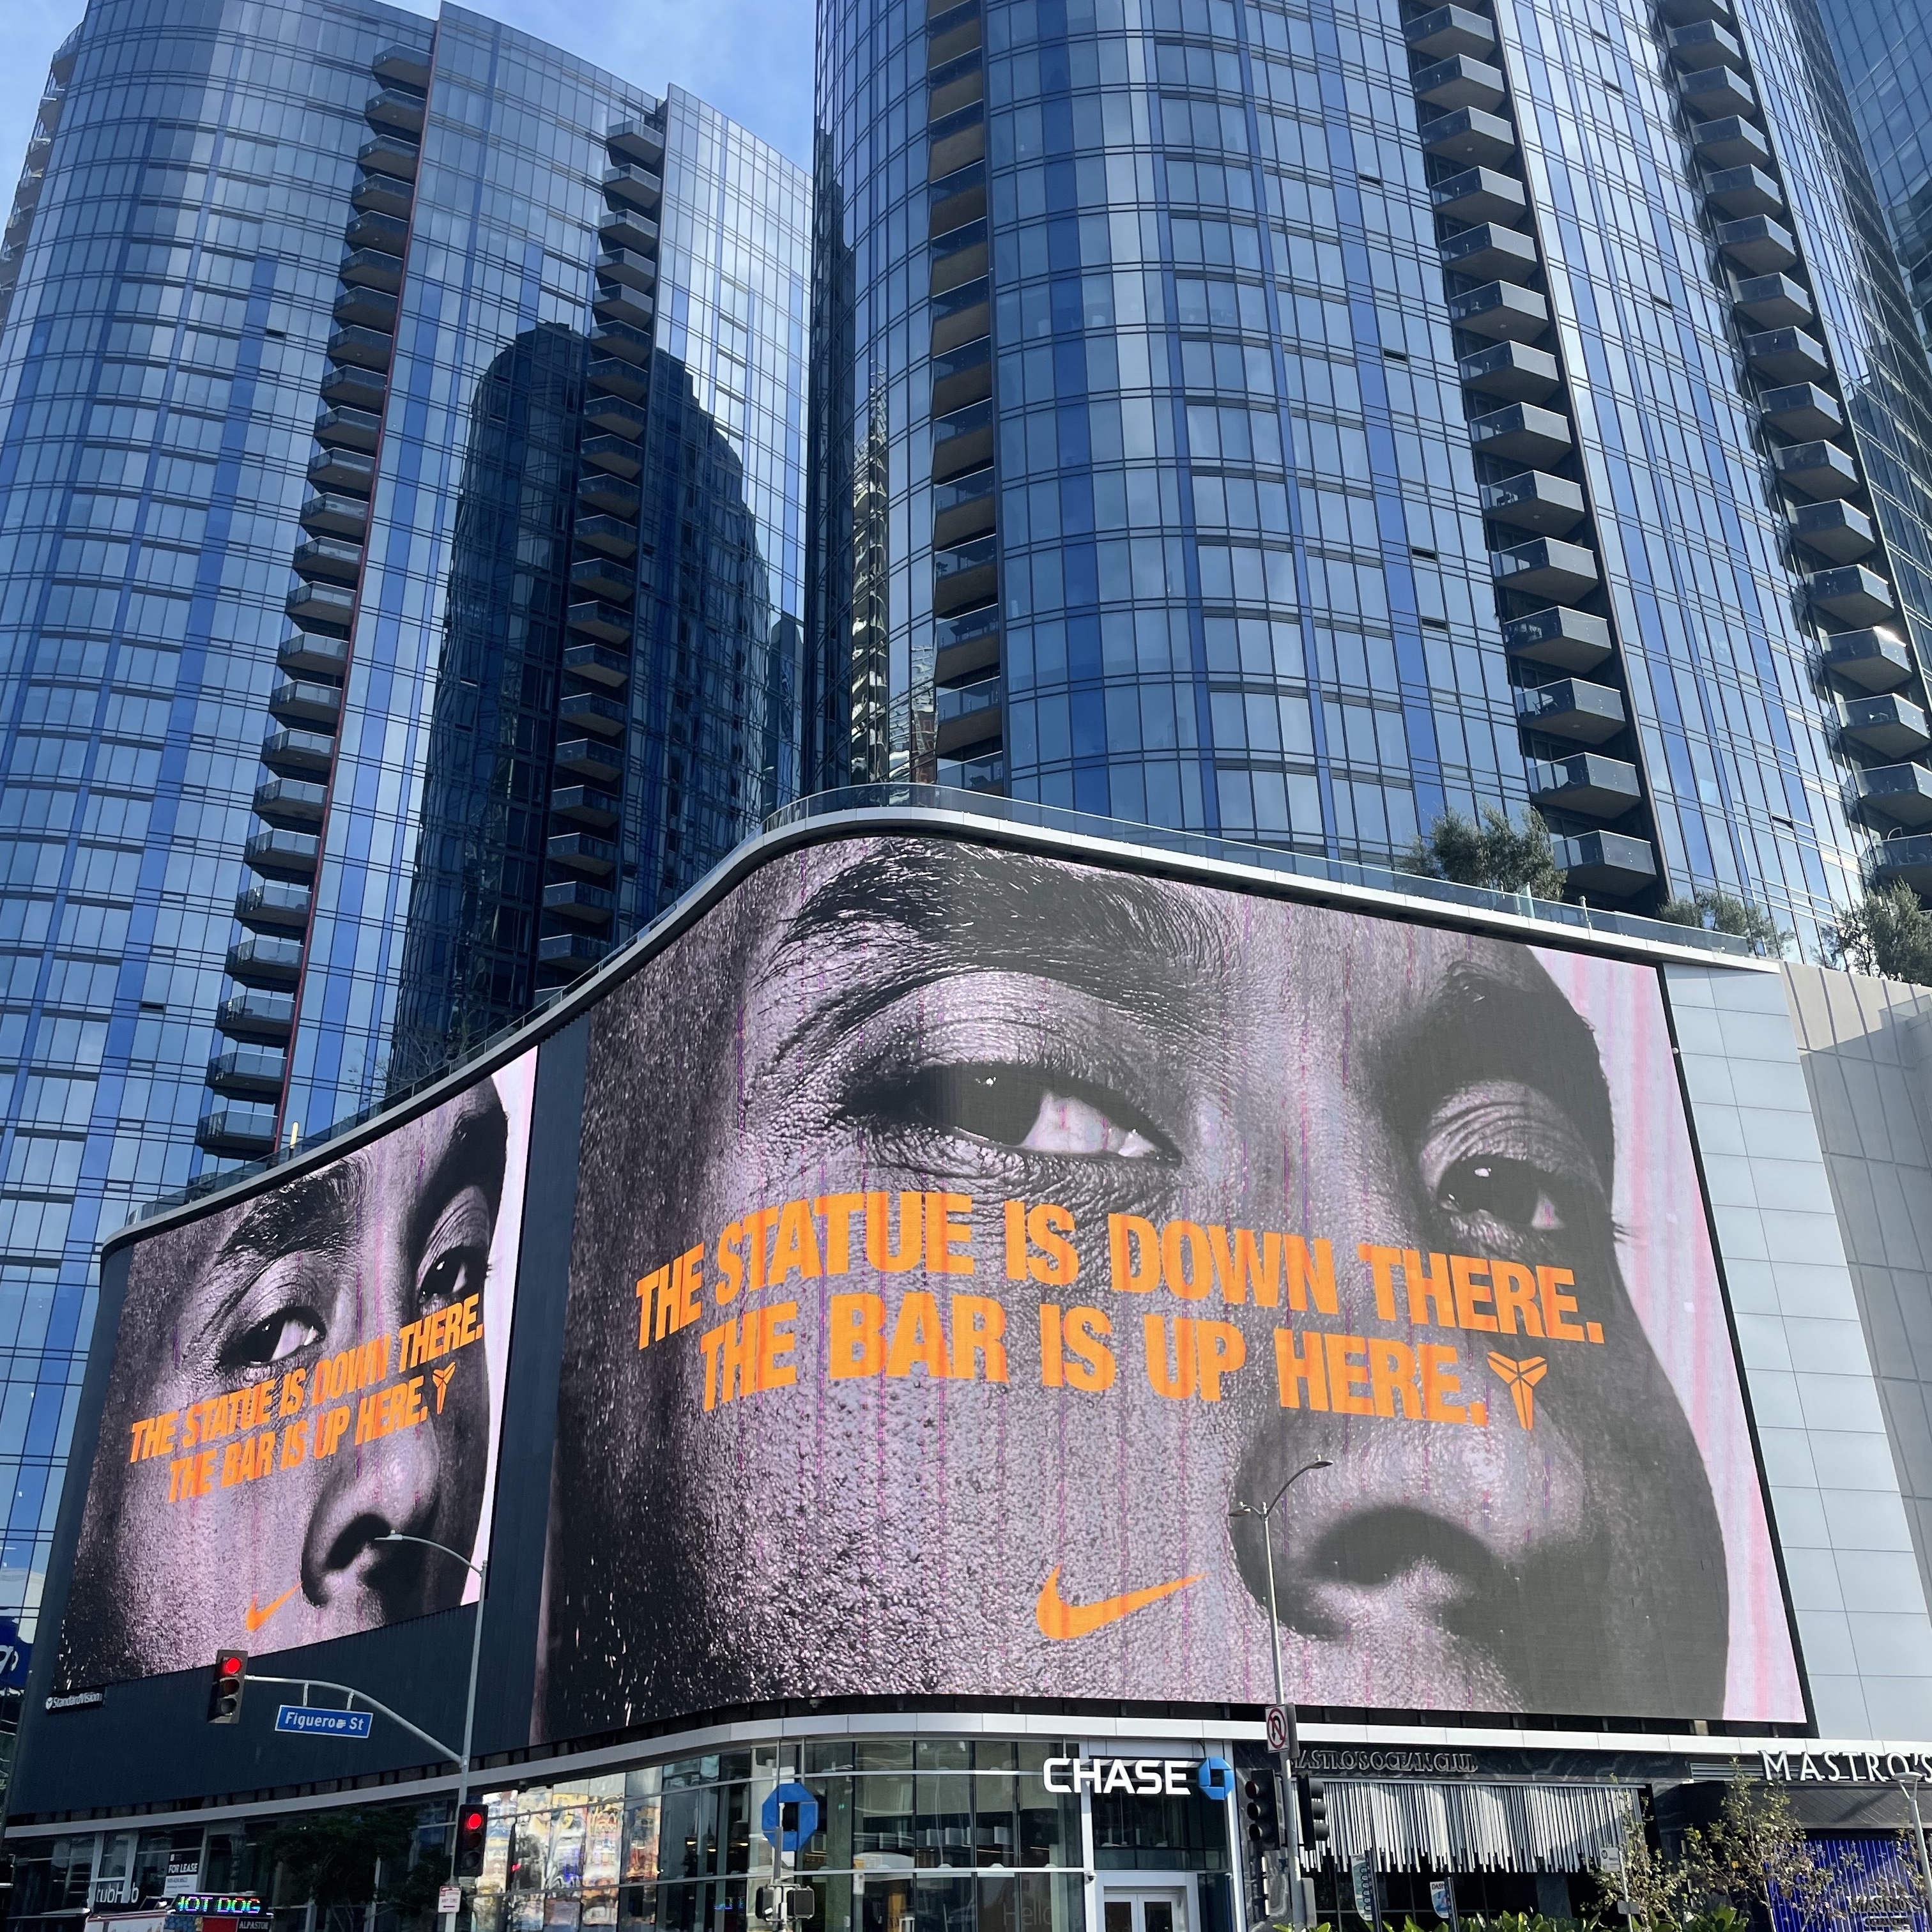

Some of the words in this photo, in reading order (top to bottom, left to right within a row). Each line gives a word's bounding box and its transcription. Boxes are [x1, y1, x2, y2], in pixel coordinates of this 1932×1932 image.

[636, 1243, 703, 1350] THE
[716, 1192, 974, 1305] STATUE
[1006, 1200, 1079, 1285] IS
[1108, 1213, 1338, 1314] DOWN
[1359, 1243, 1605, 1344] THERE.
[130, 1409, 177, 1463] THE
[181, 1381, 275, 1448] STATUE
[279, 1367, 306, 1415] IS
[312, 1334, 390, 1405] DOWN
[399, 1293, 484, 1373] THERE.
[701, 1301, 797, 1412] THE
[831, 1292, 1009, 1383] BAR
[1040, 1303, 1116, 1391] IS
[1144, 1314, 1246, 1401] UP
[1274, 1328, 1488, 1427] HERE.
[169, 1450, 217, 1503] THE
[221, 1431, 275, 1488] BAR
[281, 1420, 307, 1469] IS
[314, 1406, 350, 1459] UP
[355, 1376, 428, 1445] HERE.
[285, 1712, 346, 1729] Figueroa
[349, 1717, 364, 1730] St
[1043, 1758, 1191, 1795] CHASE
[168, 1864, 180, 1873] FOR
[180, 1863, 198, 1873] LEASE
[217, 1897, 261, 1913] DOG
